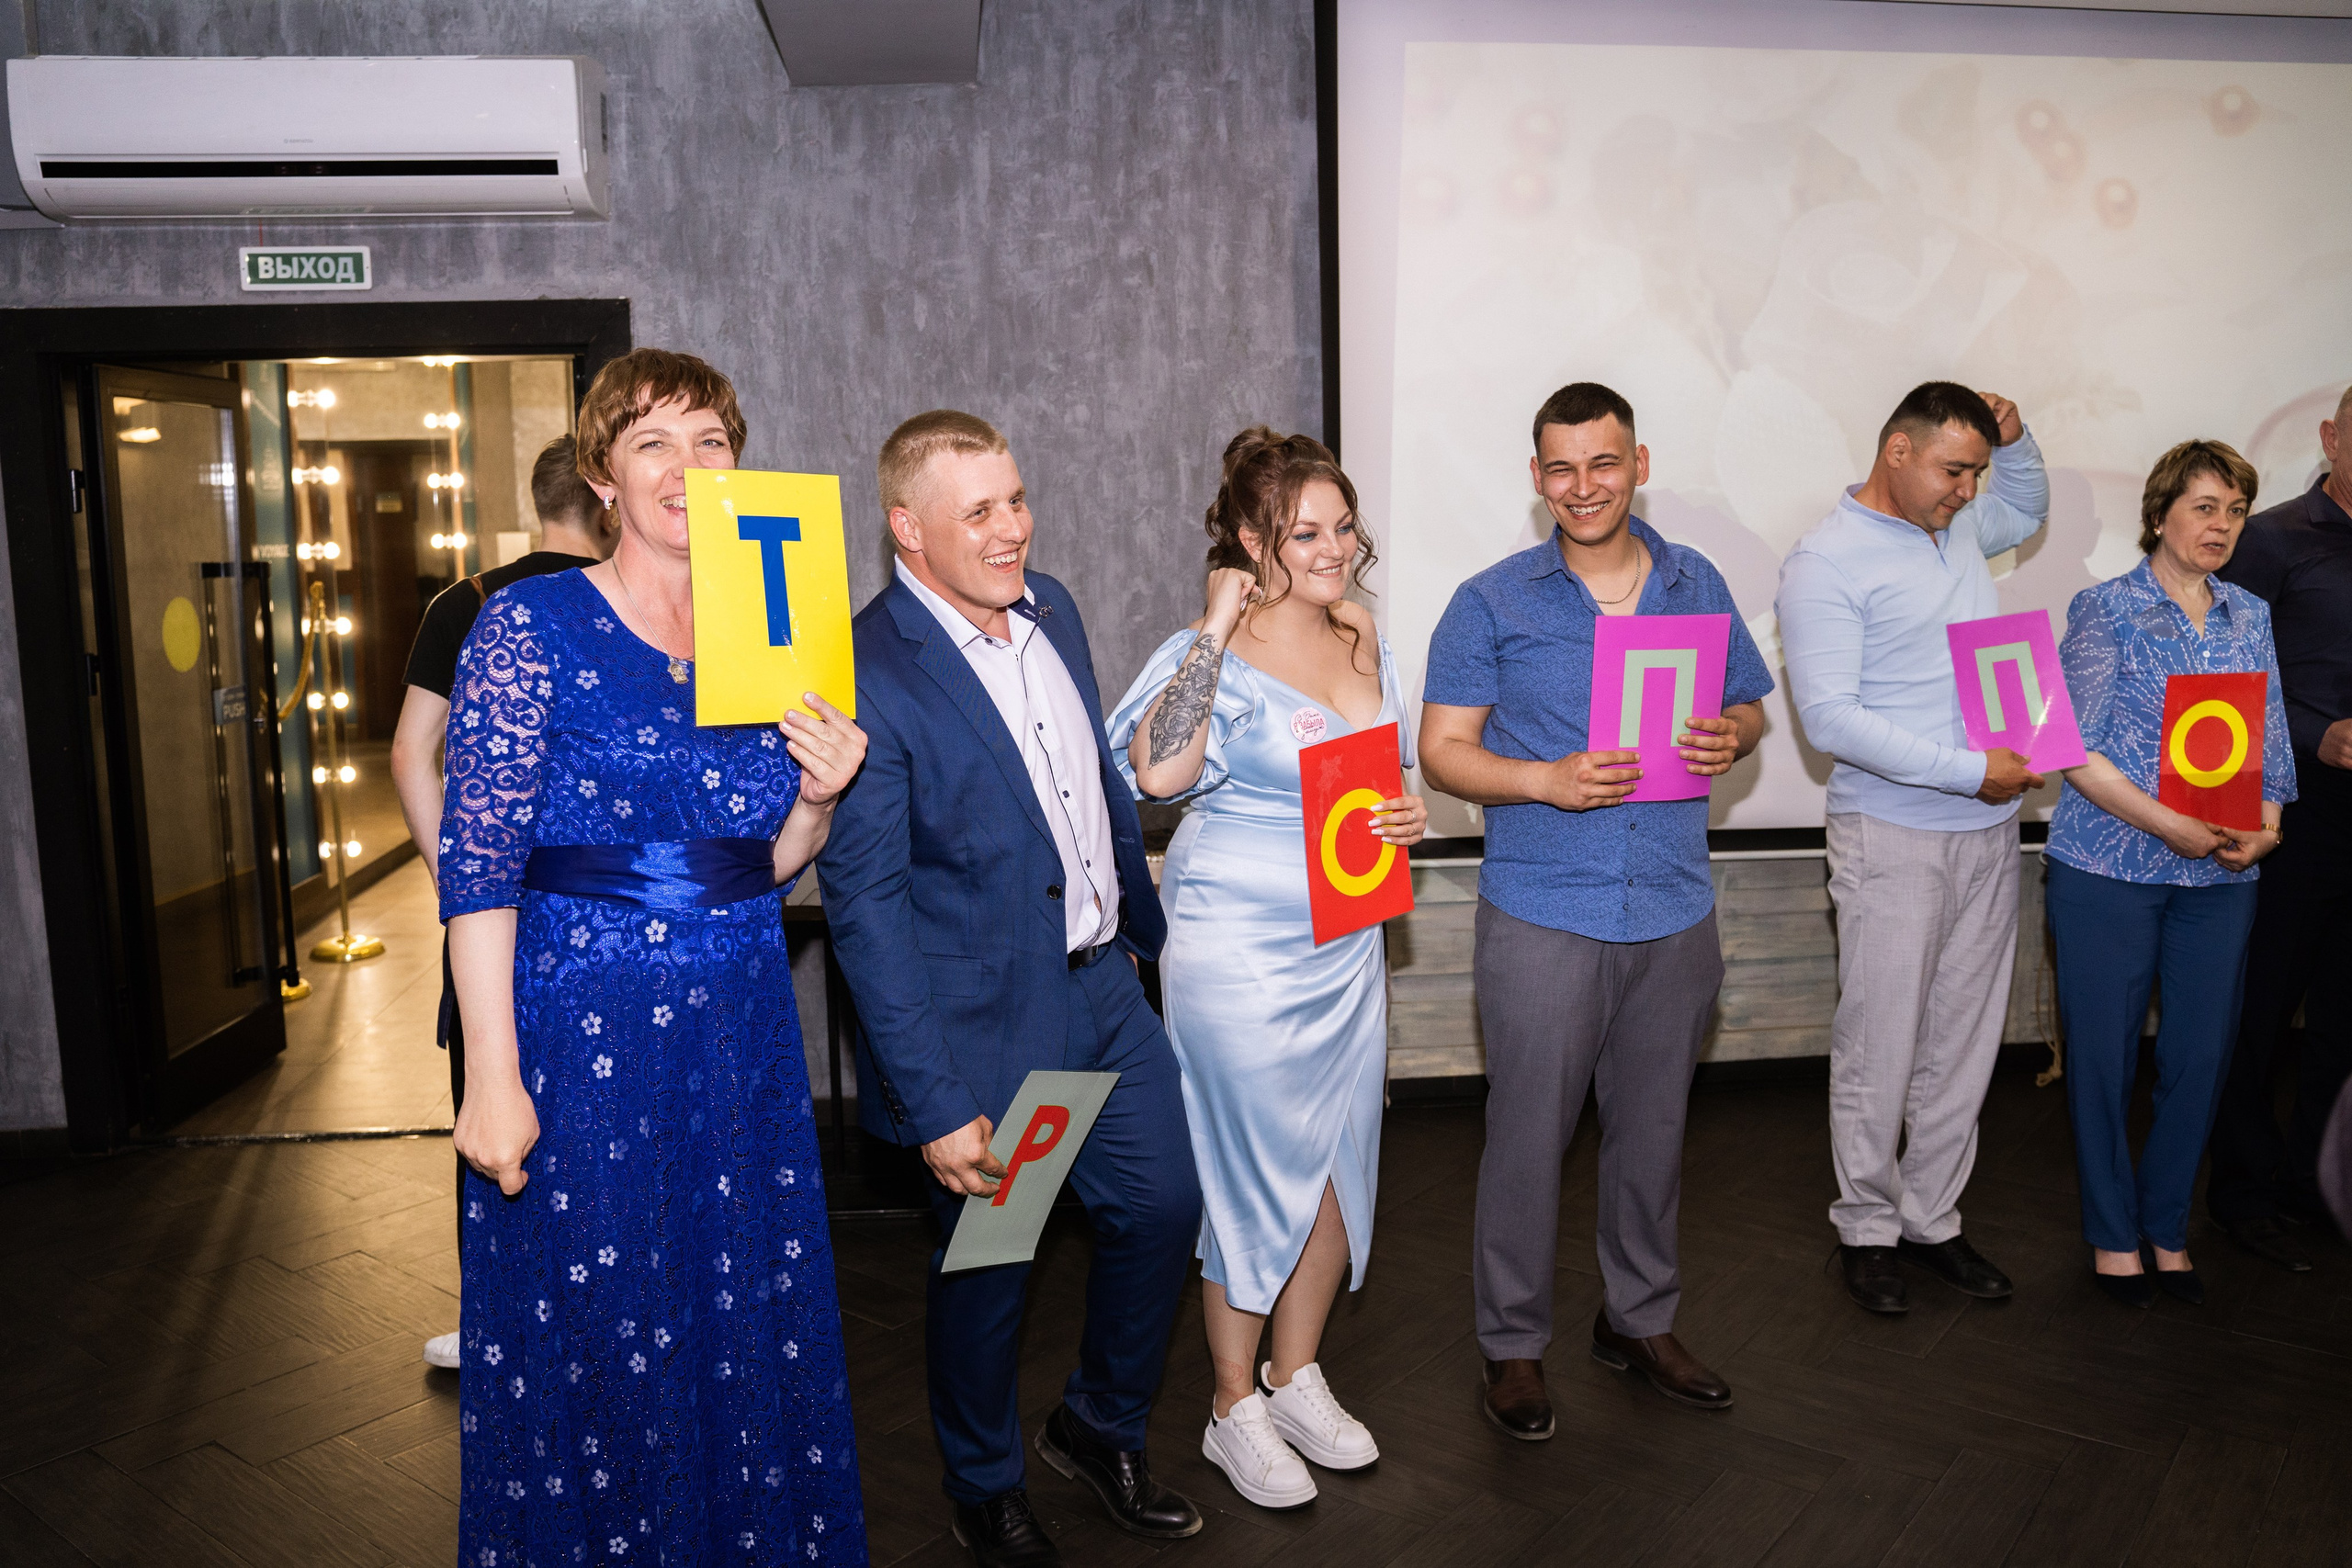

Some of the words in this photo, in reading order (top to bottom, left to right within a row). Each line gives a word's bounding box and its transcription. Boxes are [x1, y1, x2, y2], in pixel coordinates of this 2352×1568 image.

[257, 255, 356, 283] ВЫХОД
[737, 515, 802, 647] Т
[1620, 649, 1697, 747] П
[1974, 640, 2049, 733] П
[2169, 699, 2249, 788] О
[1320, 788, 1396, 897] О
[990, 1105, 1070, 1207] Р
